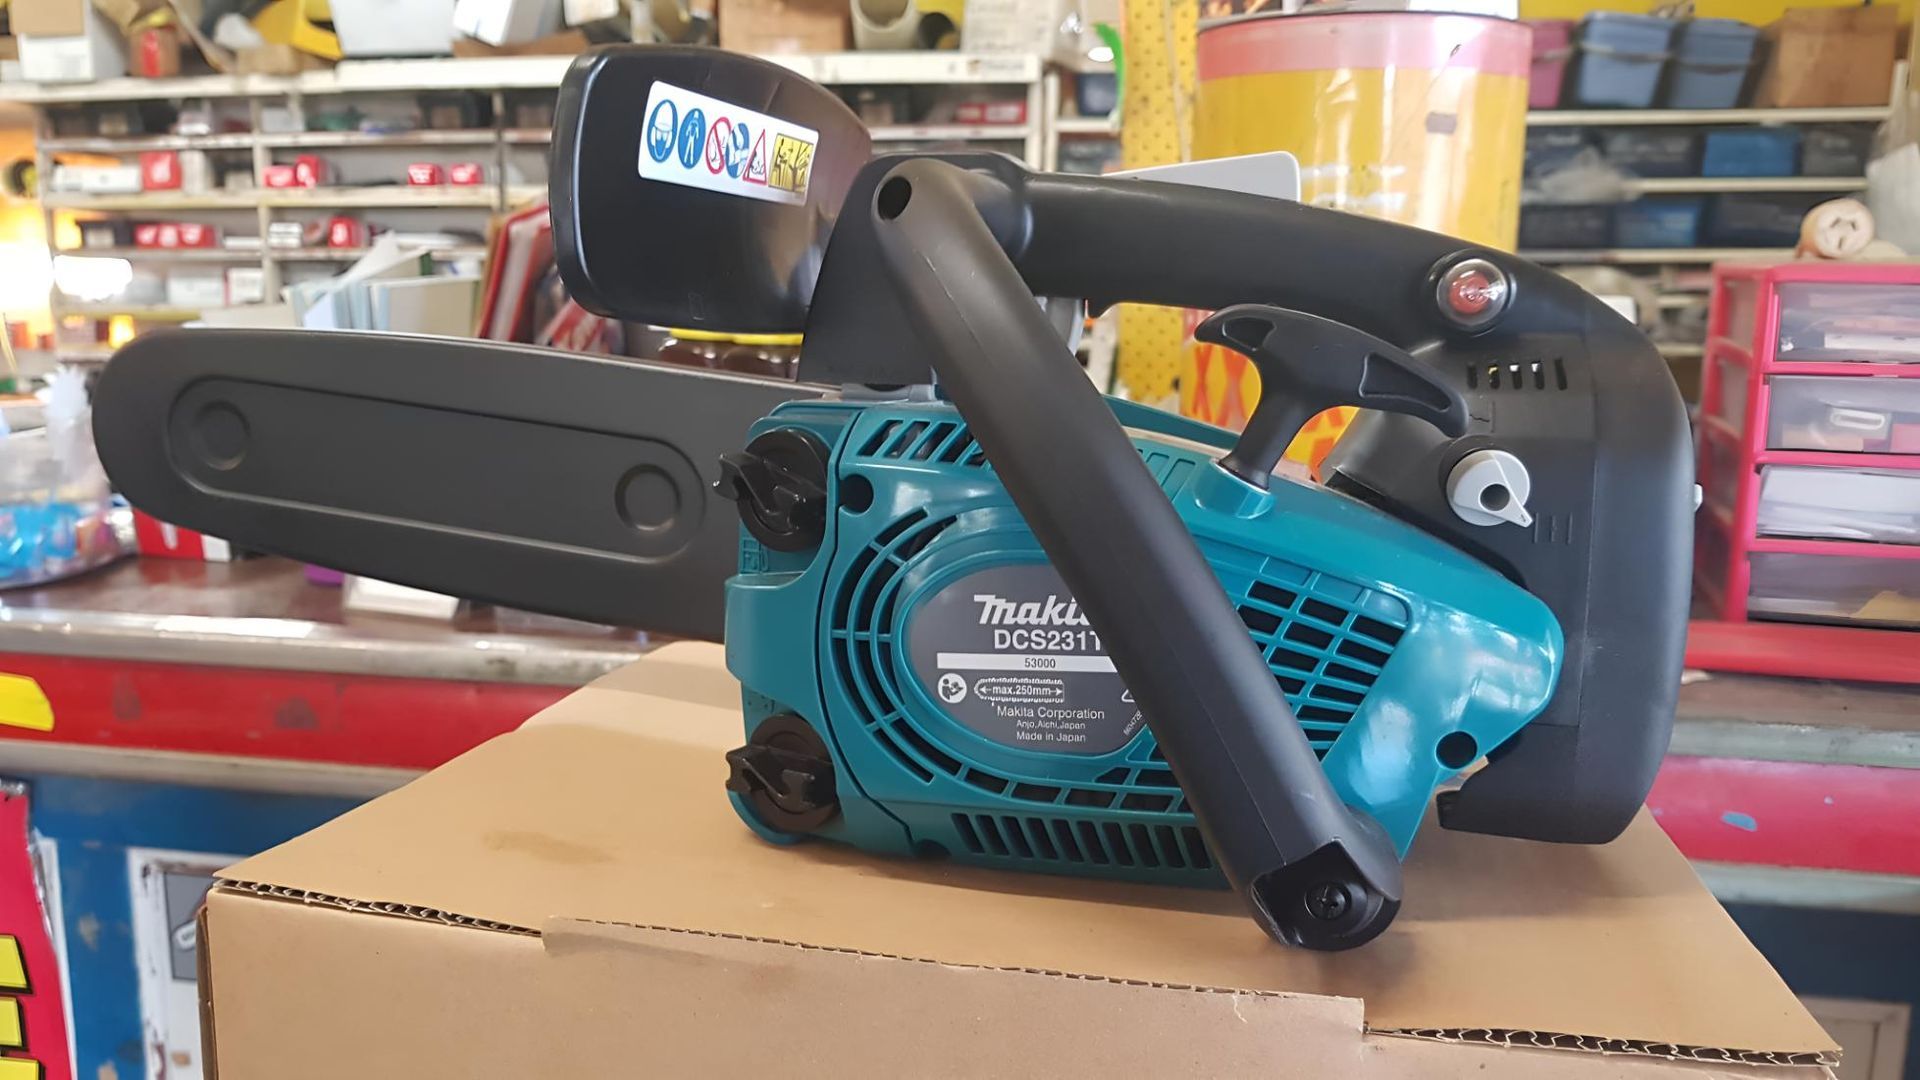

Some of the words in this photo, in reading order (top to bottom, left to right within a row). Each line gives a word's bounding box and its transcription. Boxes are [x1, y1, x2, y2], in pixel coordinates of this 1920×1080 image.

[1025, 658, 1056, 669] 53000
[992, 686, 1051, 696] max.250mm
[997, 706, 1034, 718] Makita
[1037, 707, 1105, 720] Corporation
[1016, 731, 1042, 741] Made
[1045, 731, 1053, 741] in
[1056, 733, 1086, 743] Japan
